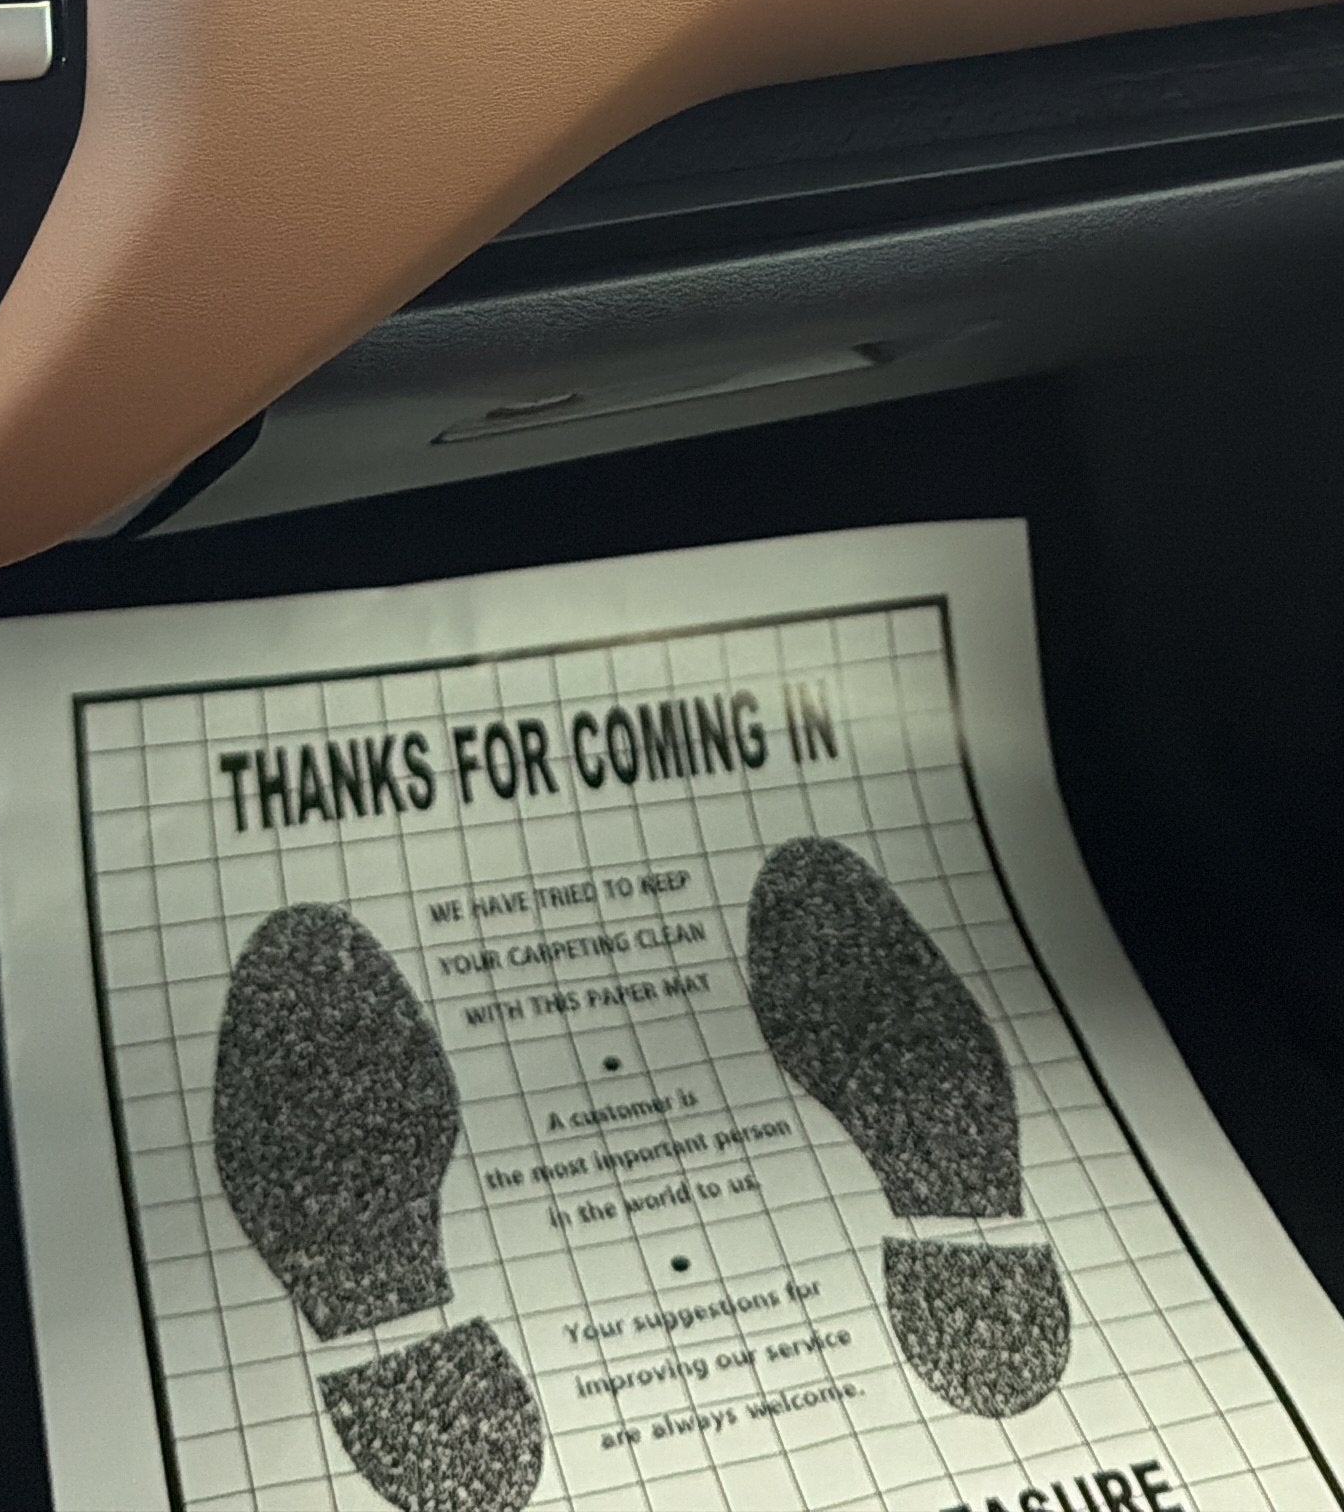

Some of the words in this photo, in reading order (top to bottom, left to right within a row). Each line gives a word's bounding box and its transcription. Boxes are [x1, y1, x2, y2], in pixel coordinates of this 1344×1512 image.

[218, 729, 436, 833] THANKS
[452, 717, 560, 804] FOR
[572, 688, 768, 789] COMING
[782, 679, 841, 764] IN
[428, 899, 463, 923] WE
[472, 890, 529, 918] HAVE
[534, 881, 597, 909] TRIED
[602, 876, 633, 899] TO
[639, 869, 691, 896] KEEP
[438, 950, 503, 977] YOUR
[509, 931, 630, 967] CARPETING
[634, 920, 706, 949] CLEAN
[464, 1000, 525, 1028] WITH
[529, 990, 581, 1016] THIS
[587, 979, 657, 1008] PAPER
[661, 973, 711, 997] MAT
[546, 1112, 564, 1131] A
[569, 1096, 673, 1128] customer
[675, 1088, 699, 1109] is
[485, 1167, 525, 1190] the
[530, 1157, 589, 1184] most
[592, 1131, 709, 1171] important
[713, 1118, 793, 1152] person
[546, 1204, 572, 1229] in
[577, 1200, 617, 1224] the
[623, 1180, 692, 1215] world
[697, 1178, 721, 1201] to
[563, 1317, 625, 1343] Your
[633, 1289, 780, 1332] suggestions
[786, 1279, 821, 1302] for
[574, 1358, 708, 1399] improving
[714, 1349, 756, 1371] our
[765, 1328, 853, 1363] service
[600, 1426, 642, 1450] are
[651, 1406, 738, 1440] always
[745, 1382, 866, 1420] welcome.
[939, 1459, 1182, 1512] URE
